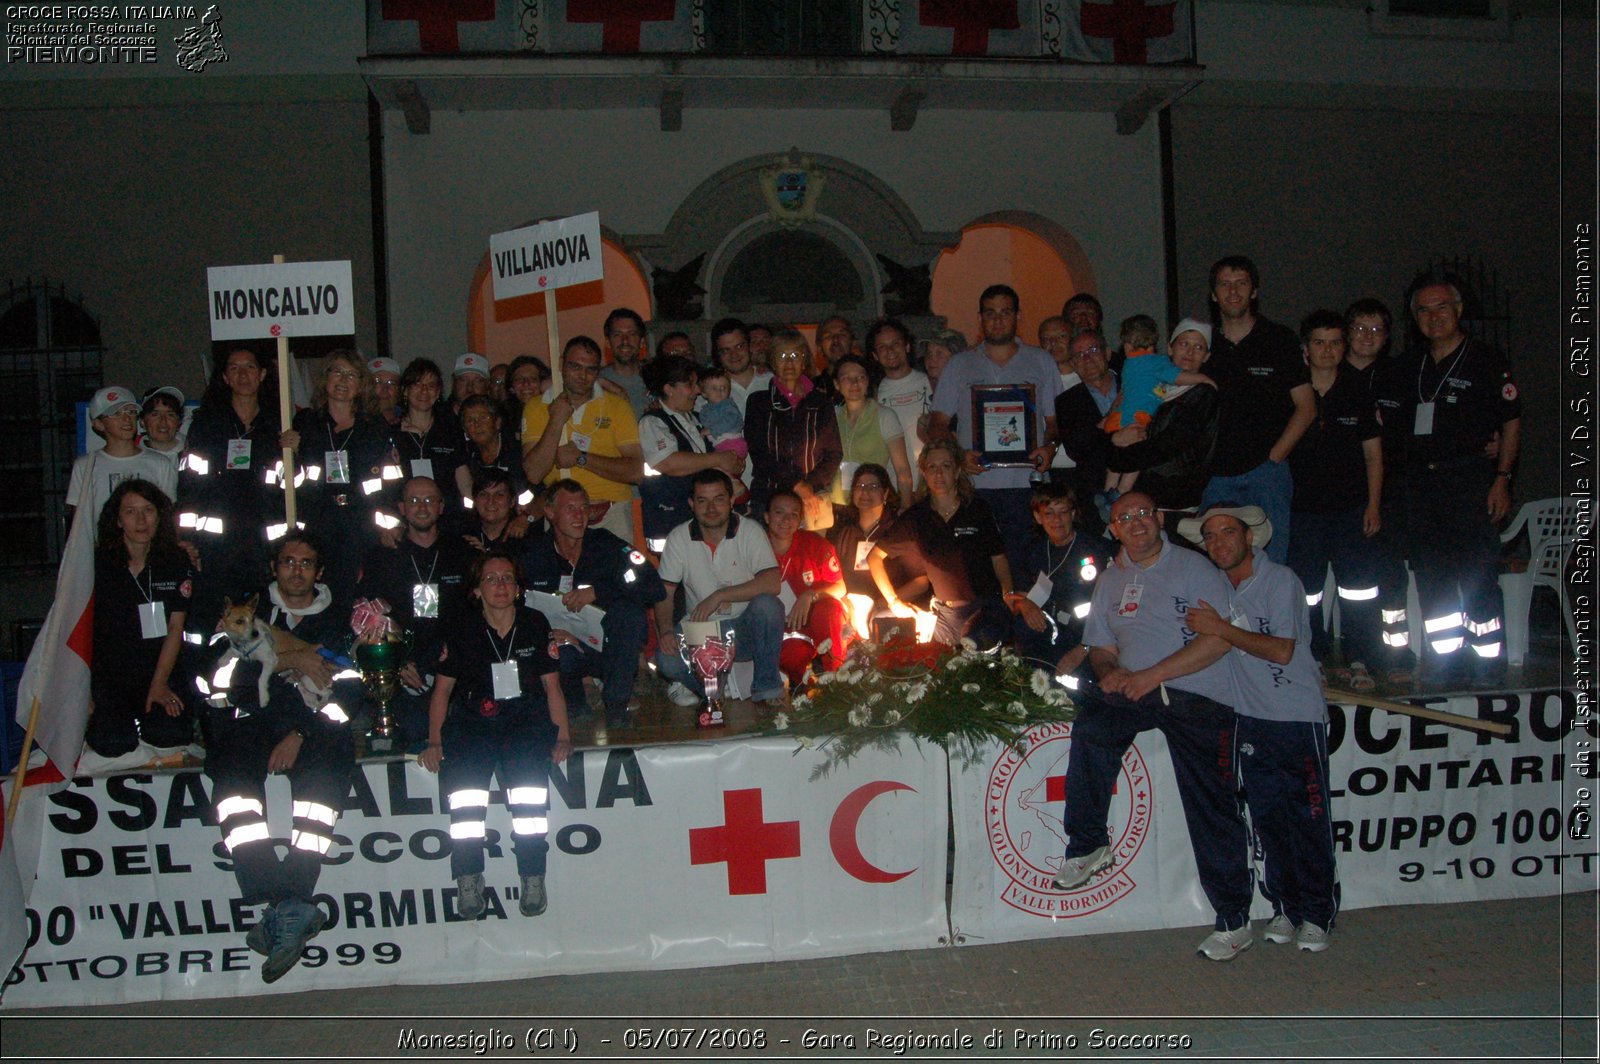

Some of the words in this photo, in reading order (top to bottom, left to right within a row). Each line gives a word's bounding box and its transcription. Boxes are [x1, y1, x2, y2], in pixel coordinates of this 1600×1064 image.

[494, 233, 591, 279] VILLANOVA
[213, 283, 339, 321] MONCALVO
[989, 751, 1020, 800] CROC
[1028, 722, 1070, 745] ROSS
[1334, 811, 1477, 852] RUPPO
[61, 843, 192, 879] DEL
[89, 898, 254, 940] "VALLE
[312, 886, 520, 931] ORMIDA"
[1011, 887, 1056, 911] VALLE
[1060, 879, 1128, 911] BORMIDA
[301, 942, 402, 969] 999
